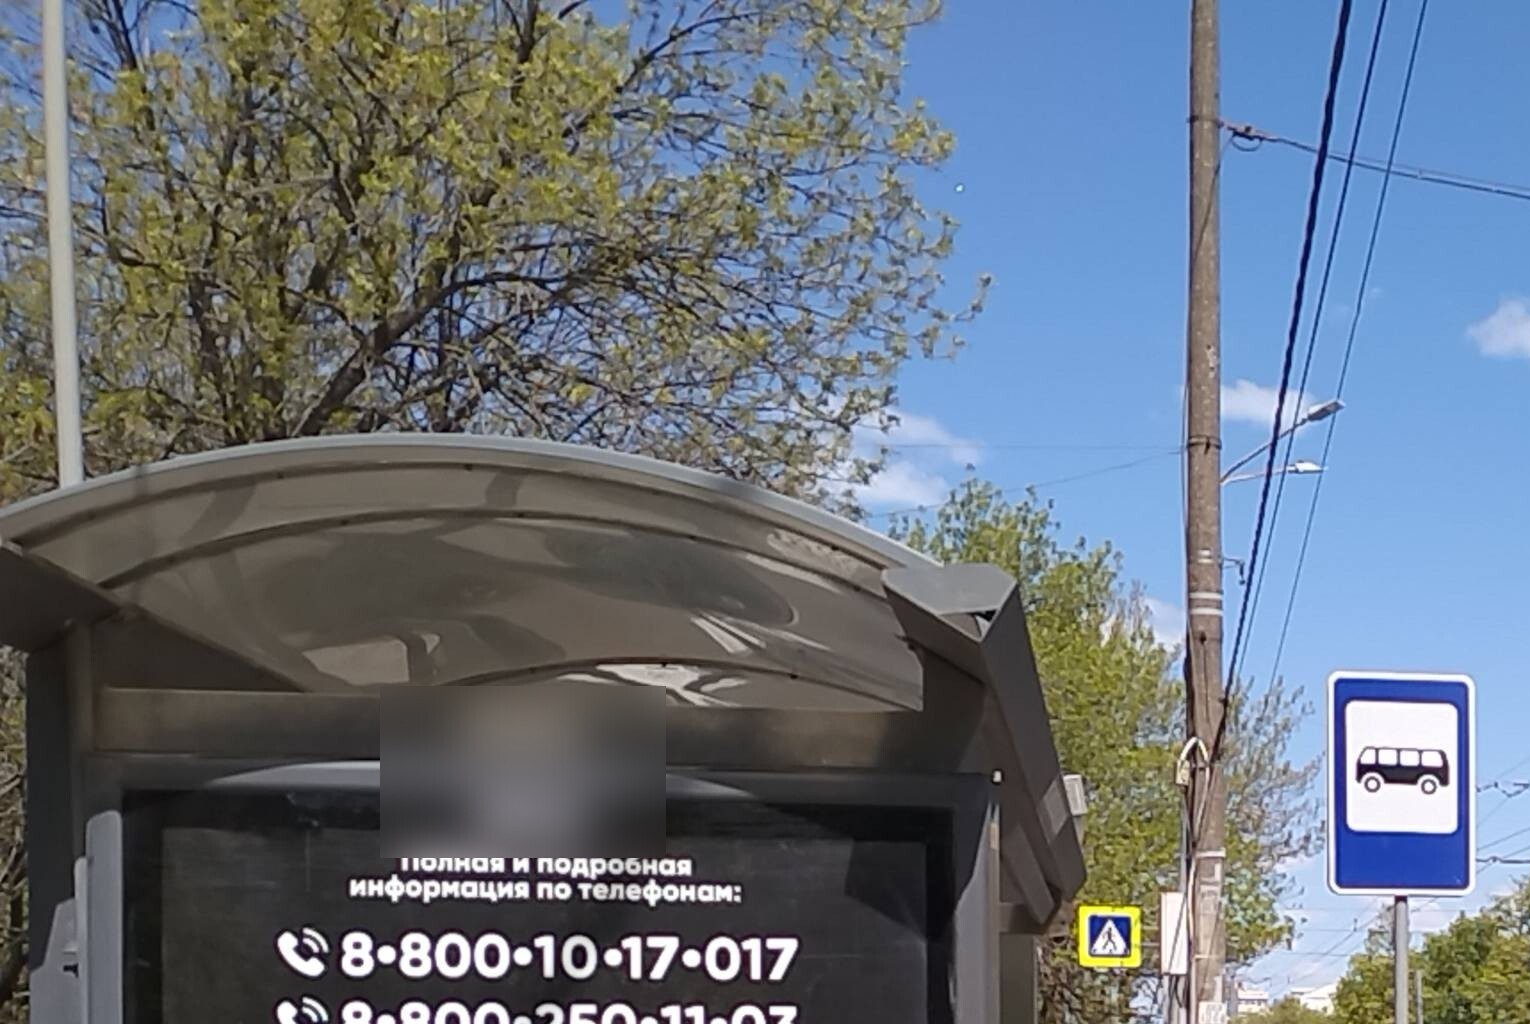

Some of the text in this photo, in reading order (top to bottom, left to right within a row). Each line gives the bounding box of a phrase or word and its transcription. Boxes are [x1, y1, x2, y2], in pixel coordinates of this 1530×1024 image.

[512, 857, 530, 873] и
[349, 873, 742, 907] информация по телефонам:
